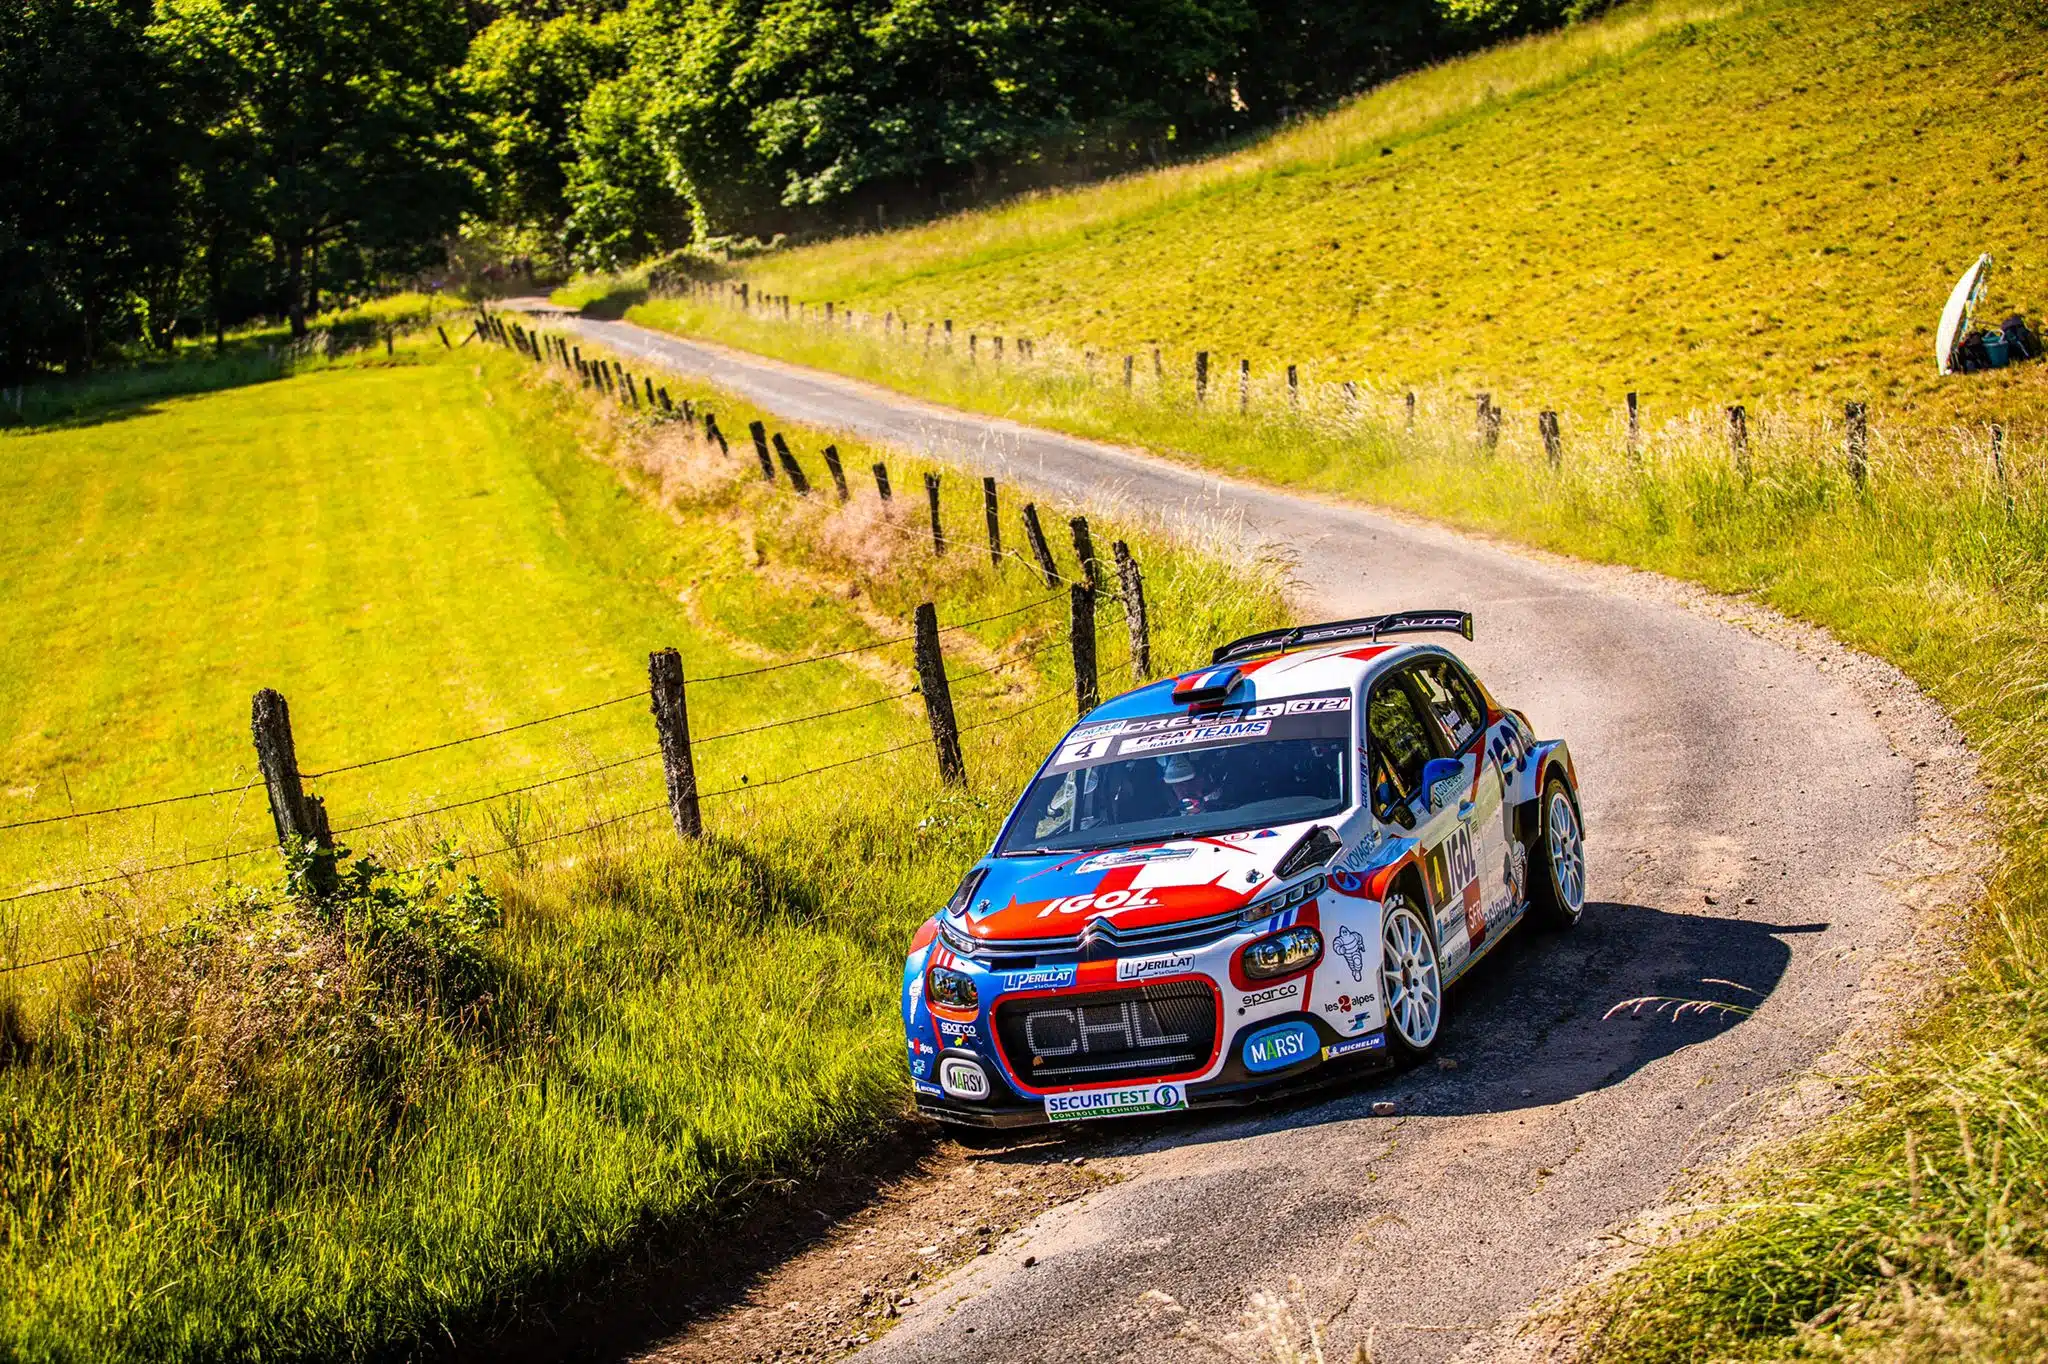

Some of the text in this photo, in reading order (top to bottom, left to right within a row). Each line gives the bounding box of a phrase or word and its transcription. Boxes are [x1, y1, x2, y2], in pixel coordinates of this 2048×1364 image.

[1394, 617, 1460, 627] AUTO
[1289, 697, 1349, 712] GT2i
[1121, 709, 1243, 732] ORECA
[1193, 721, 1267, 738] TEAMS
[1074, 741, 1097, 758] 4
[1149, 738, 1186, 748] RALLYE
[1447, 823, 1476, 895] IGOL
[1432, 855, 1445, 902] 4
[1468, 899, 1483, 930] SFR
[1242, 984, 1298, 1006] sparco
[1324, 993, 1375, 1013] les 2 alpes
[941, 1022, 976, 1035] sparco
[1026, 1000, 1189, 1056] CHL
[1251, 1031, 1304, 1063] MARSY
[1339, 1037, 1380, 1053] MICHELIN
[949, 1070, 982, 1092] MARSY
[1050, 1089, 1149, 1111] SECURITEST
[1052, 1105, 1151, 1119] CONTROLE TECHNIQUE
